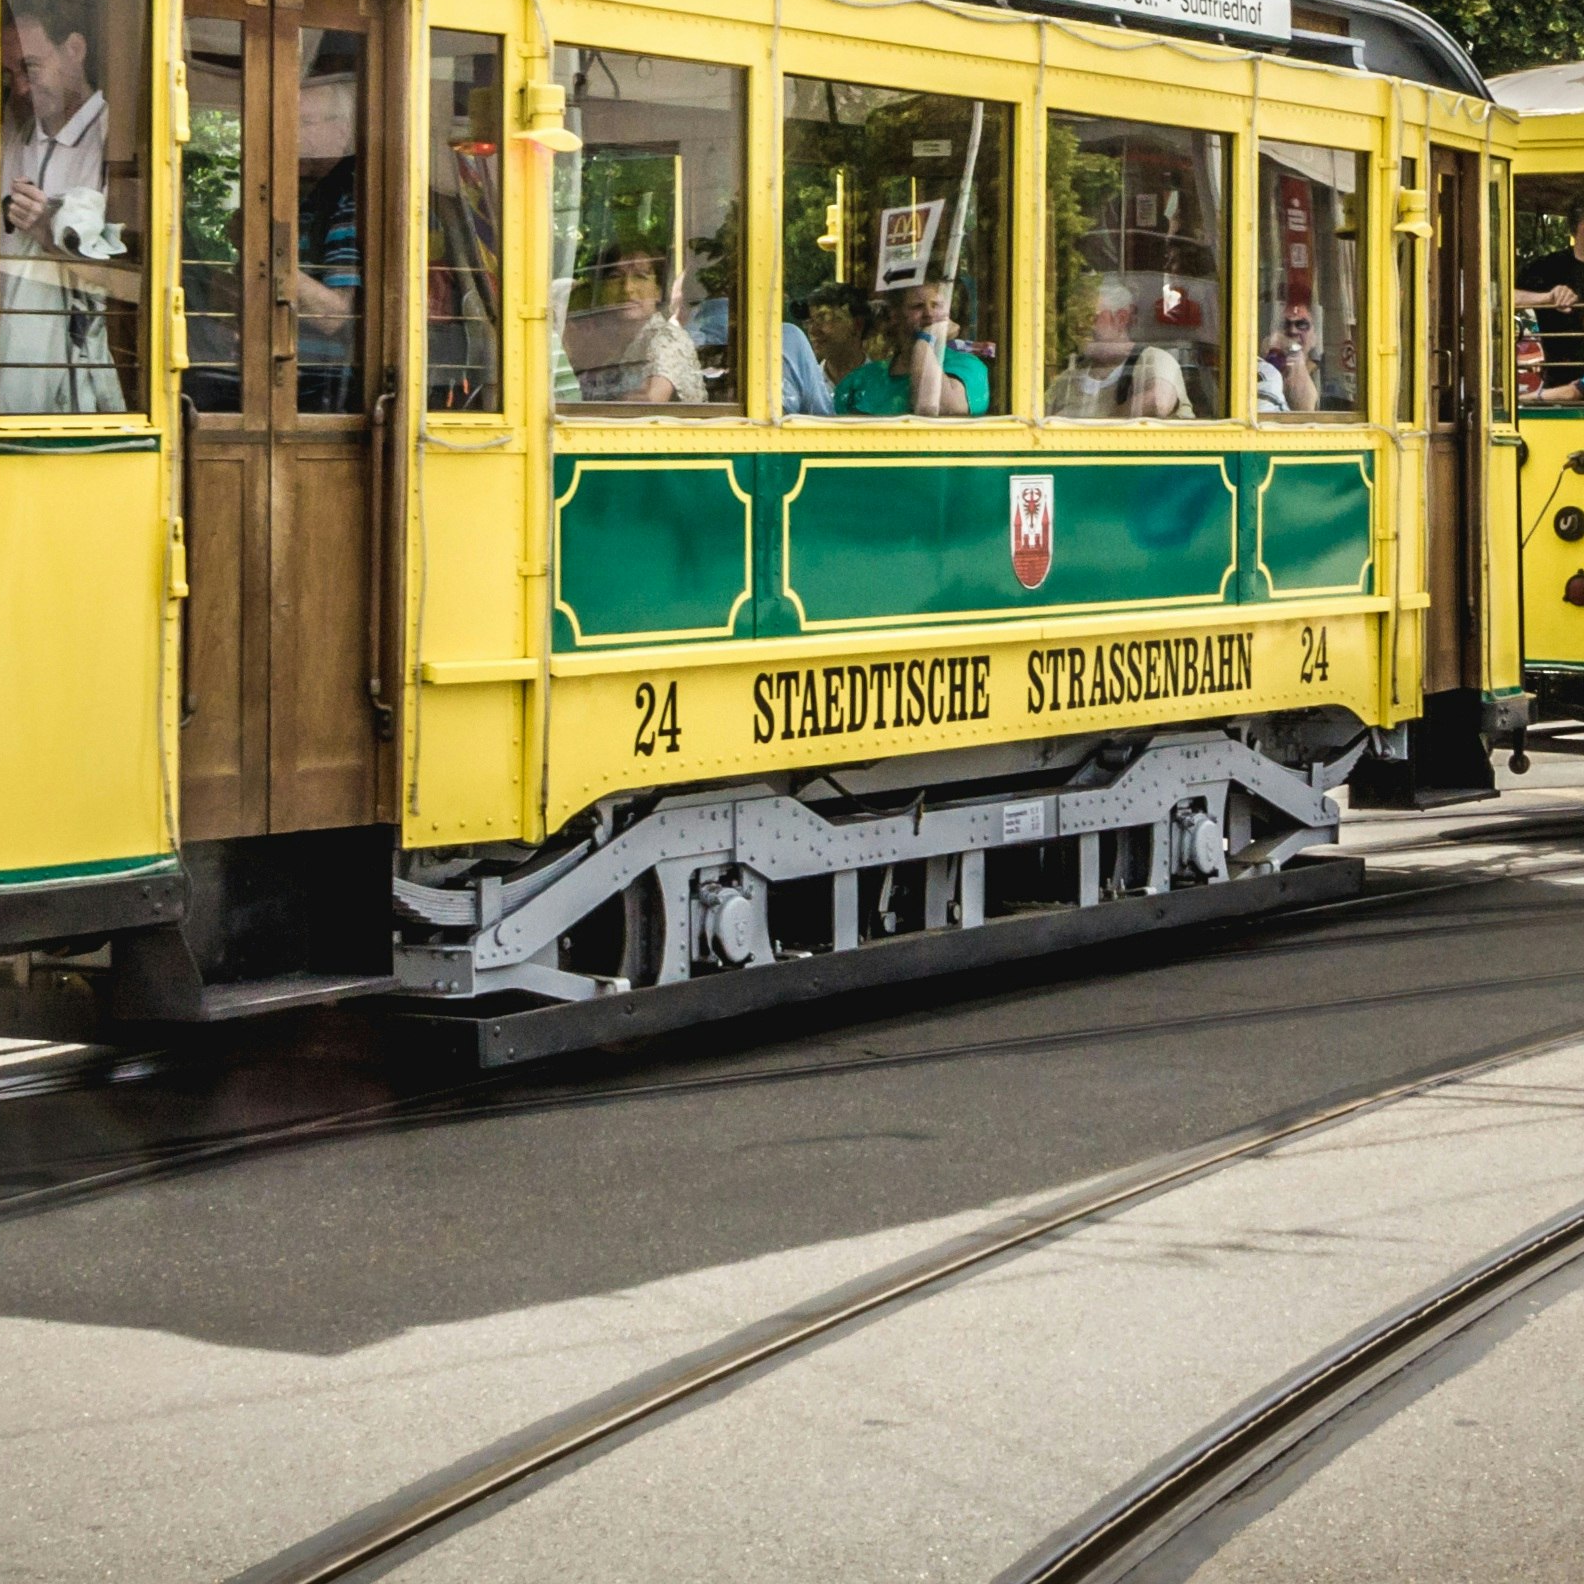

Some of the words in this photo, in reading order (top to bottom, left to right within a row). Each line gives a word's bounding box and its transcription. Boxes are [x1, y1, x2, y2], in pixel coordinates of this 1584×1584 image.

[634, 681, 682, 757] 24
[753, 655, 990, 744] STAEDTISCHE
[1027, 632, 1253, 714] STRASSENBAHN
[1300, 626, 1329, 684] 24
